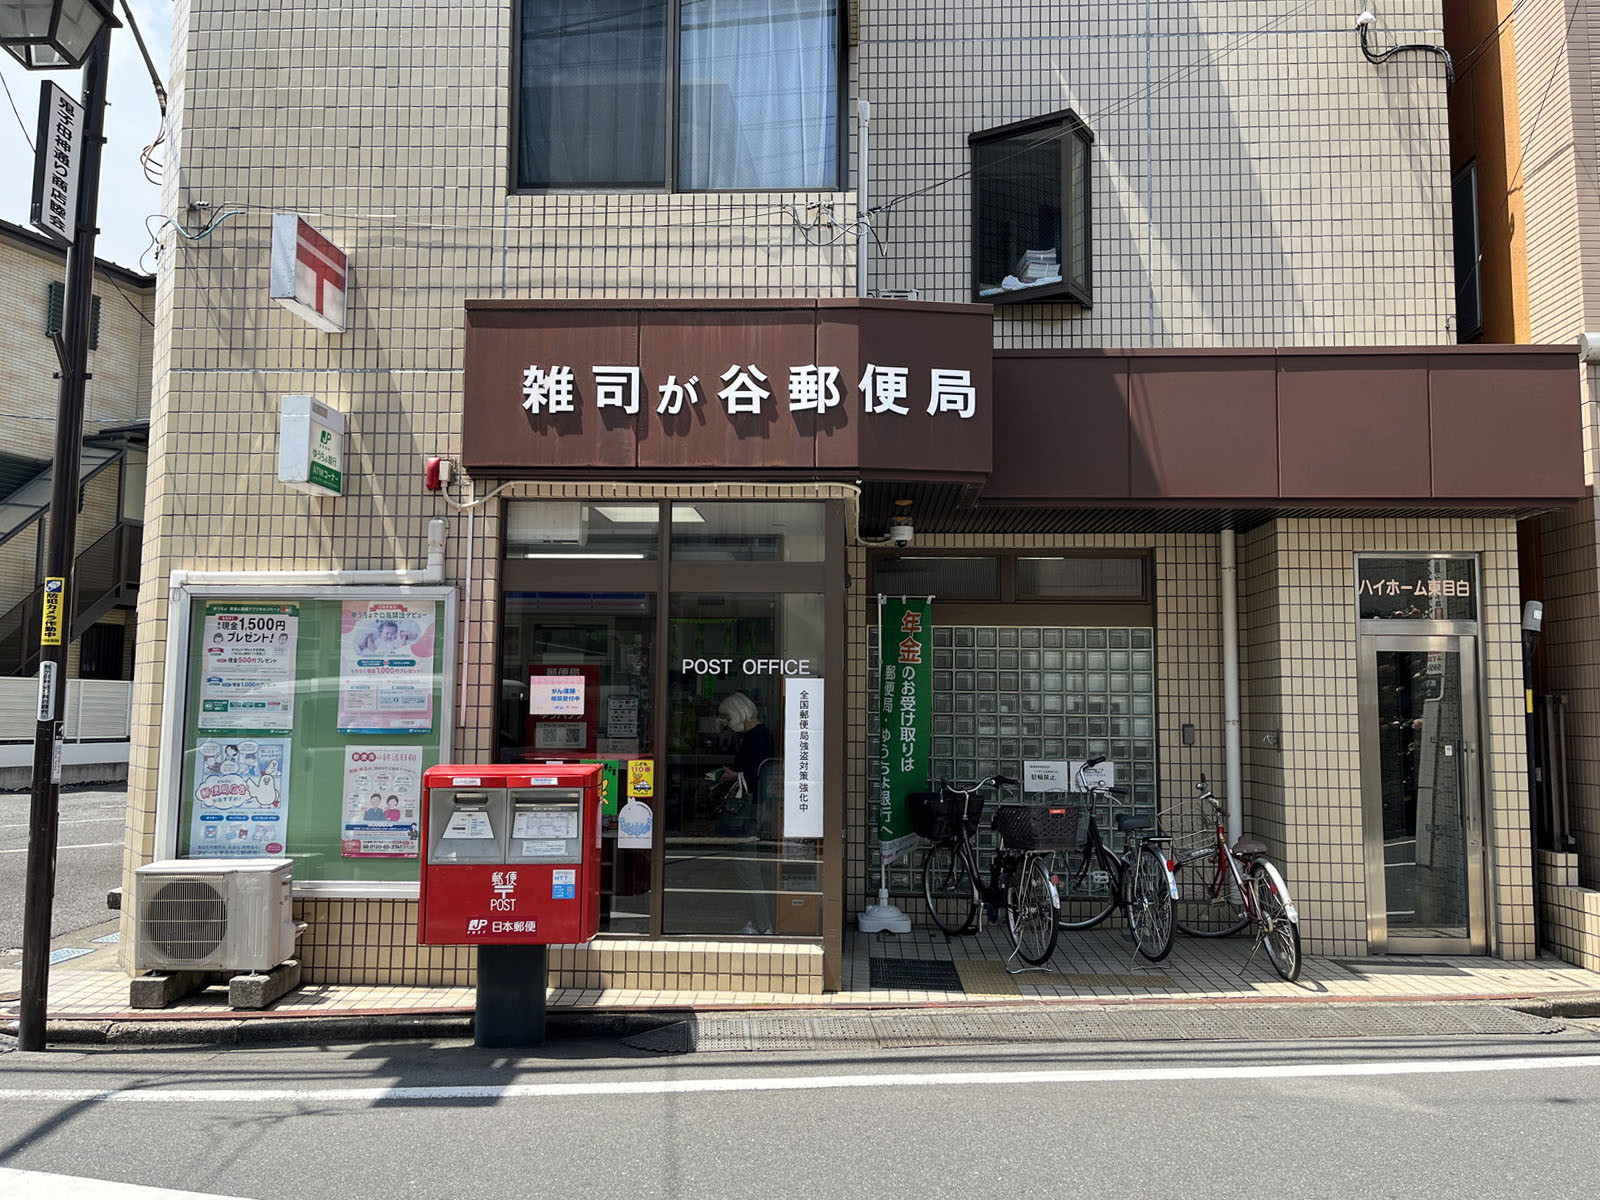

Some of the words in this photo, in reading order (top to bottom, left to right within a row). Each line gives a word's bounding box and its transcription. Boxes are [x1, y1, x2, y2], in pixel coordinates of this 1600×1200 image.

[522, 363, 977, 418] 雑司が谷郵便局
[312, 449, 337, 467] ゆうちょ銀行
[312, 466, 339, 481] ATMコーナー
[1359, 579, 1470, 597] ハイホーム東目白
[682, 659, 733, 675] POST
[742, 659, 811, 675] OFFICE
[898, 610, 923, 772] 年金のお受け取りは
[799, 690, 809, 812] 全国郵便局強盗対策強化中
[491, 871, 518, 886] 郵便
[490, 898, 516, 911] POST
[492, 920, 537, 933] 日本郵便
